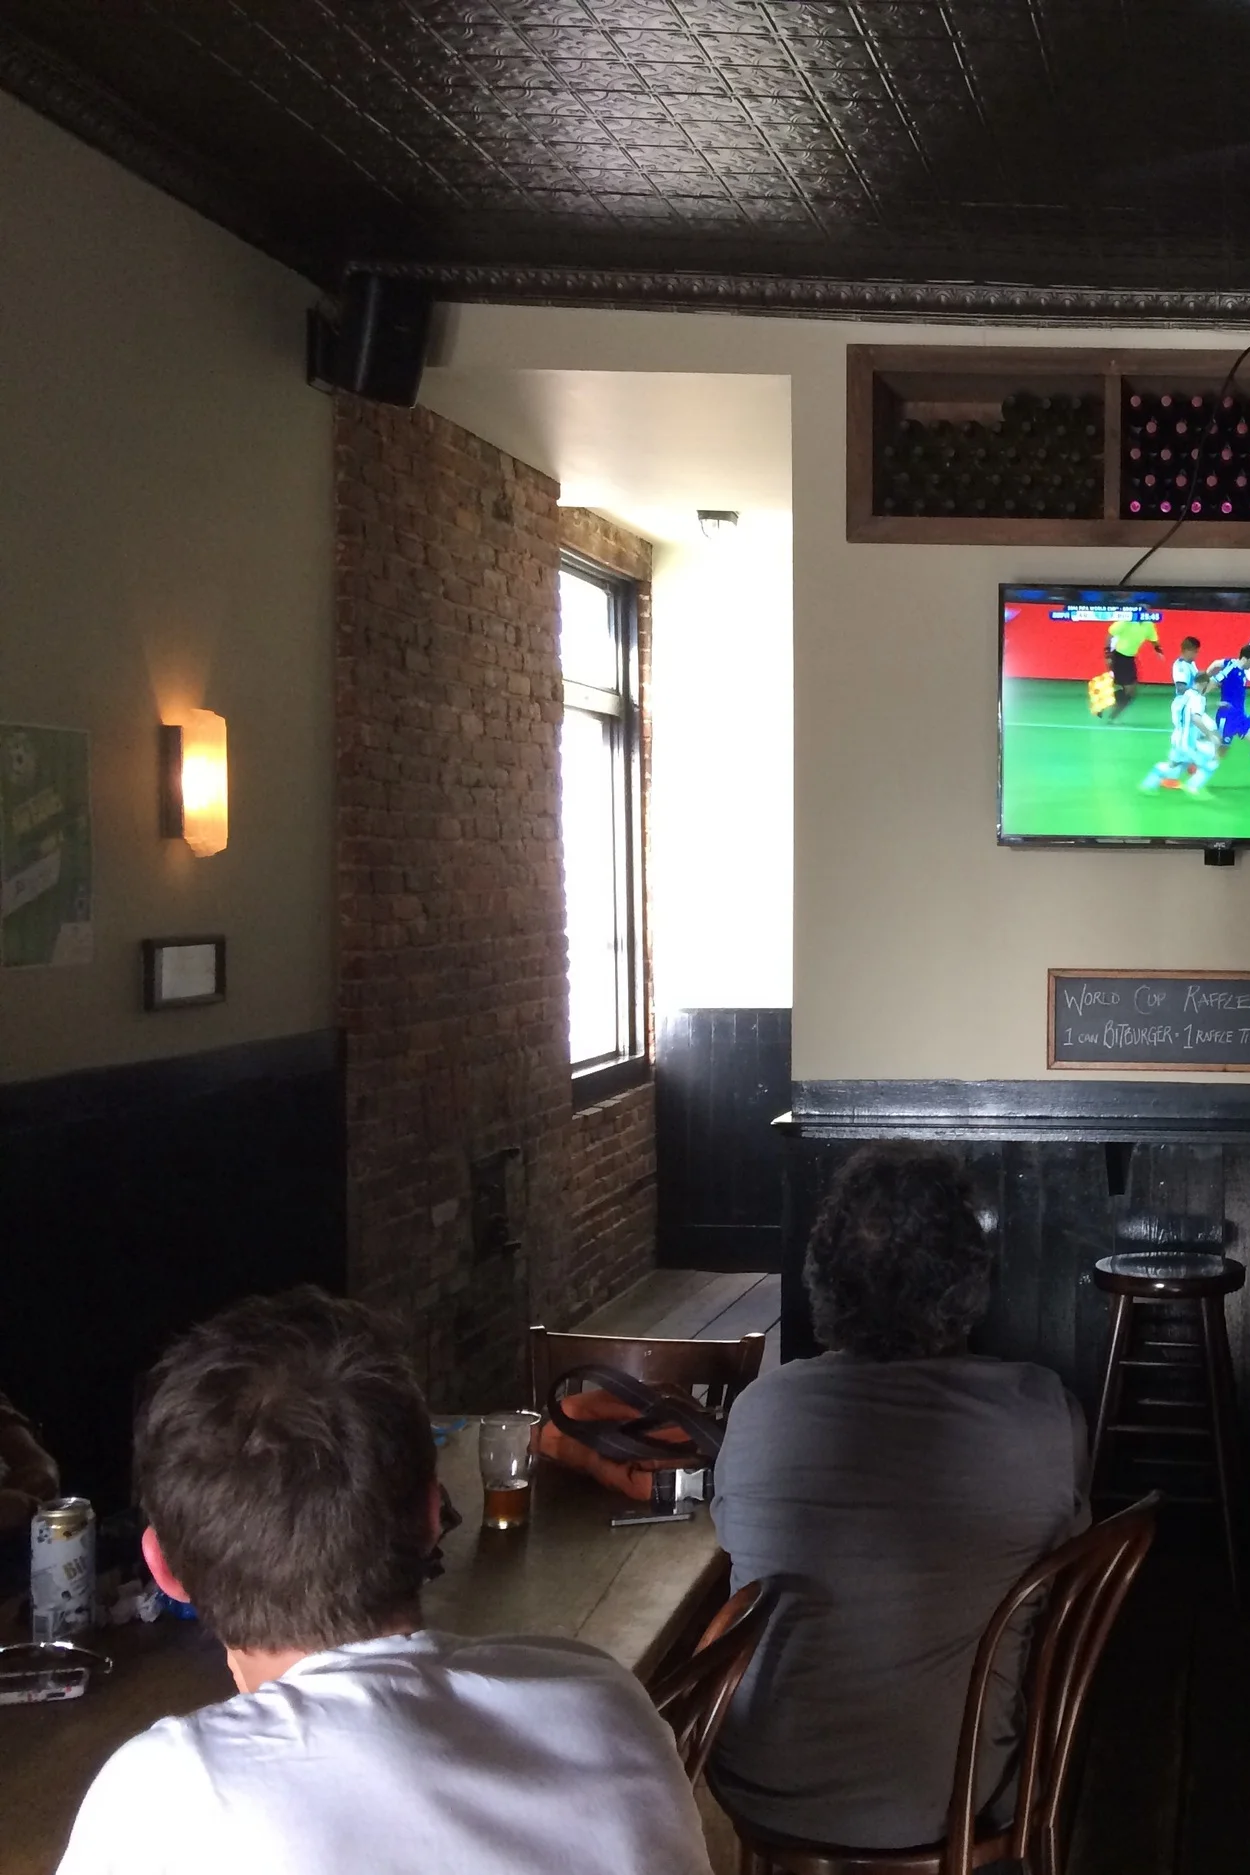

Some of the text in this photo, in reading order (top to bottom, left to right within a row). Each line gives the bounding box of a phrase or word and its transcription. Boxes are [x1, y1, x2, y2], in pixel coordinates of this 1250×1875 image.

[1064, 984, 1120, 1016] WORLD
[1134, 985, 1167, 1015] CUP
[1063, 1027, 1074, 1046] 1
[1103, 1019, 1173, 1049] BITBURGER
[1183, 1023, 1194, 1049] 1
[1196, 1030, 1233, 1043] RAFFLE
